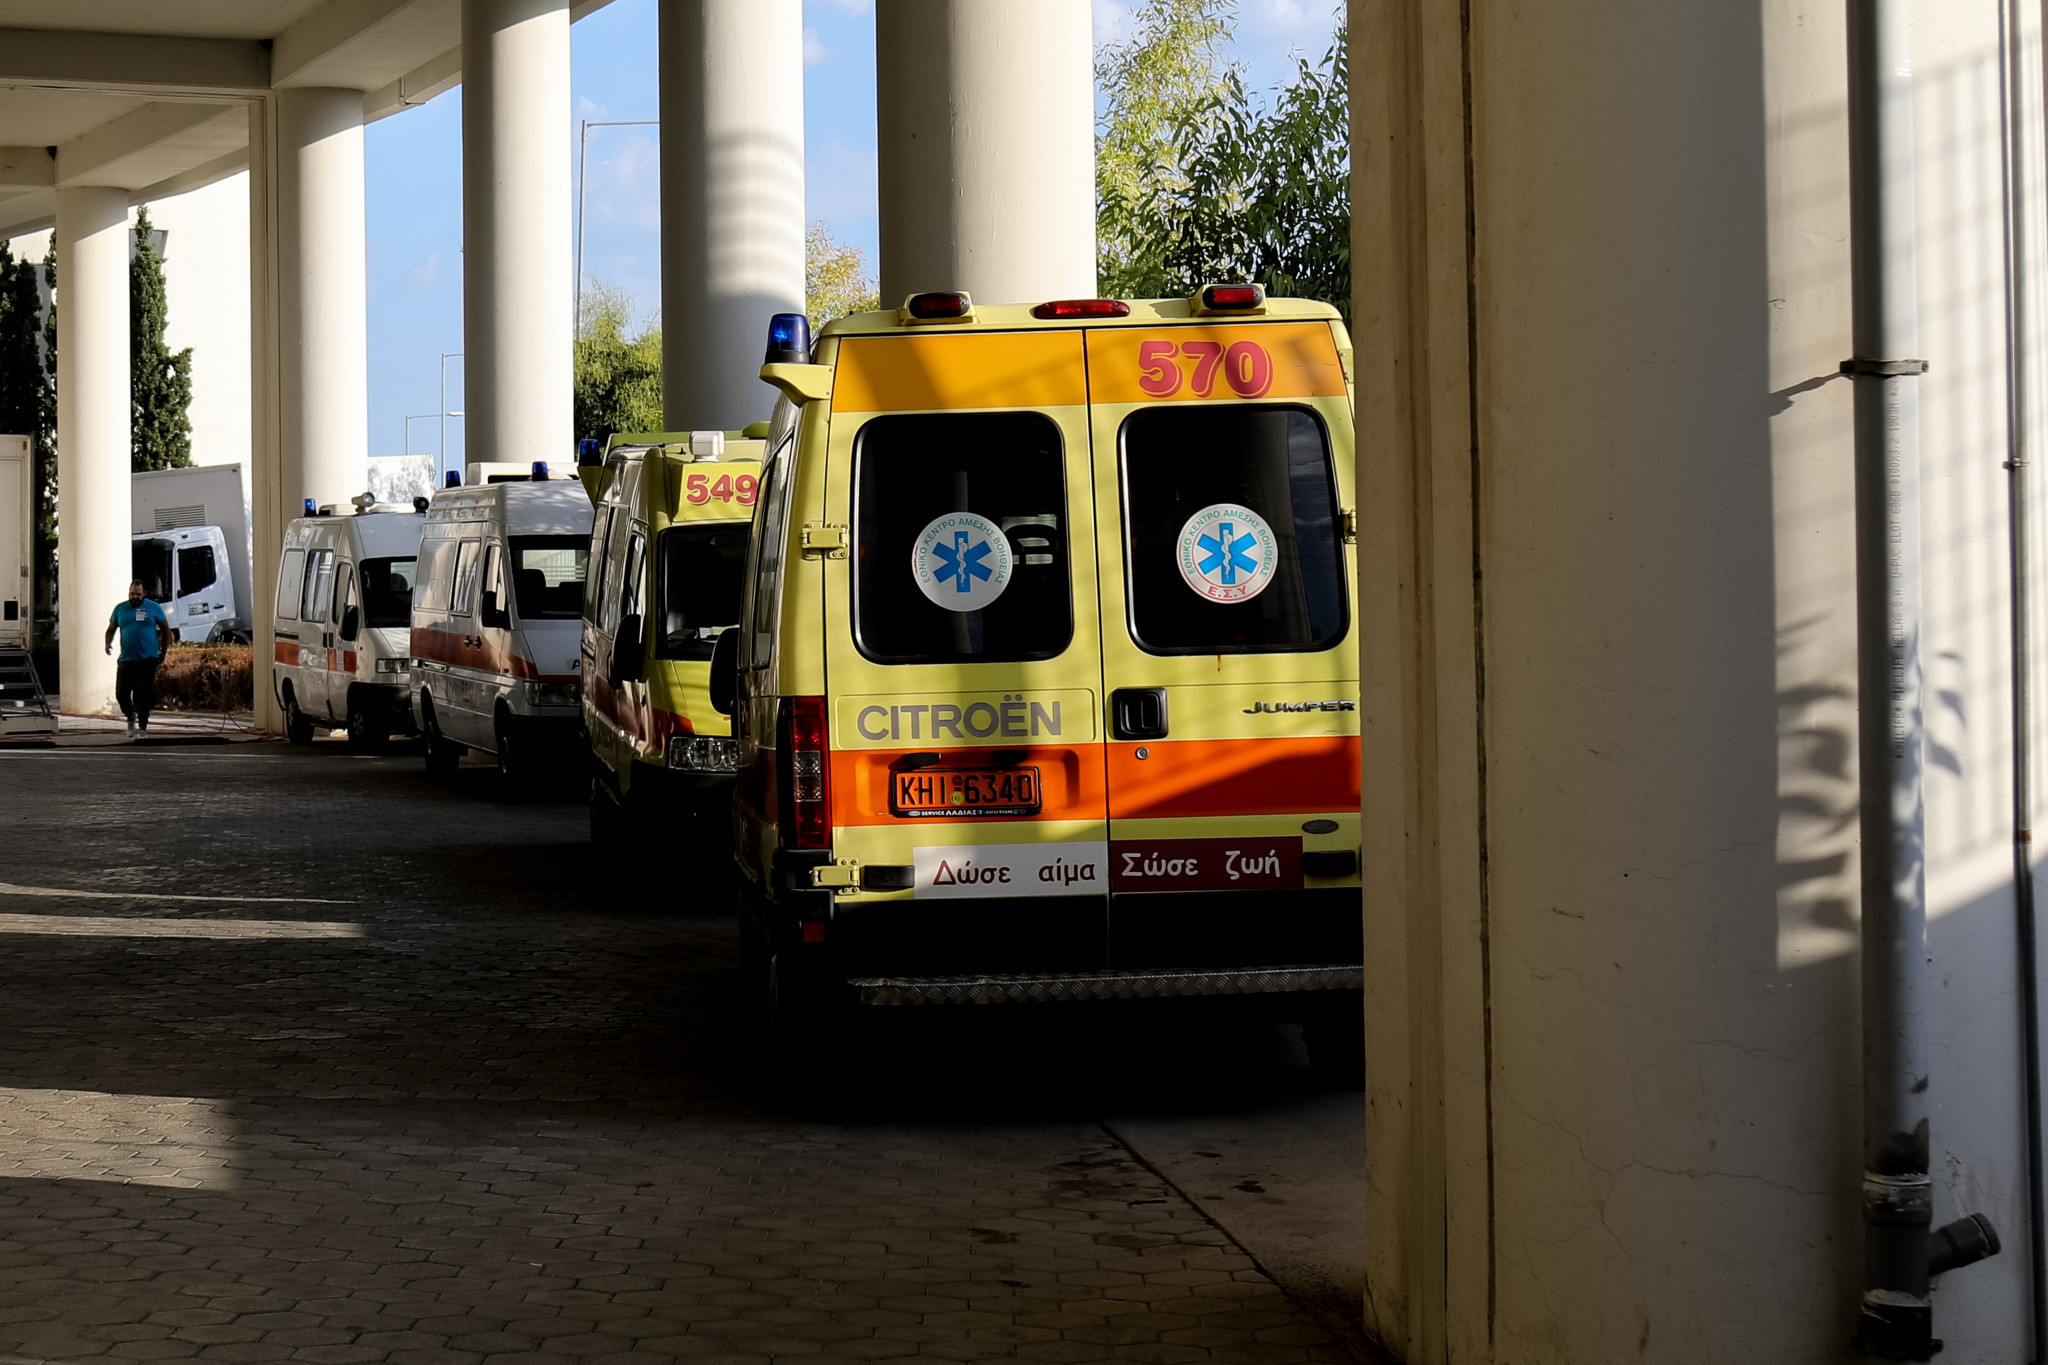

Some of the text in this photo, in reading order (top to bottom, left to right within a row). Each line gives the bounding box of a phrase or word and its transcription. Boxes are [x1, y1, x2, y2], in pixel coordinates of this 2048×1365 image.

[1138, 340, 1274, 399] 570
[687, 473, 760, 507] 549
[1182, 509, 1273, 577] ΕΘΝΙΚΟ ΚΕΝΤΡΟ ΑΜΕΣΗΣ ΒΟΗΘΕΙΑΣ
[1889, 520, 1902, 544] ELOT
[918, 517, 1008, 585] ΕΘΝΙΚΟ ΚΕΝΤΡΟ ΑΜΕΣΗΣ ΒΟΗΘΕΙΑΣ
[1889, 550, 1902, 579] U-PVC
[1891, 613, 1904, 649] HELLAS
[1891, 655, 1904, 701] PIPELIFE
[857, 693, 1062, 741] CITROËN
[1242, 700, 1356, 715] JUMPER
[933, 857, 1096, 886] Δώσε αίμα
[1121, 849, 1282, 880] Σώσε ζωή
